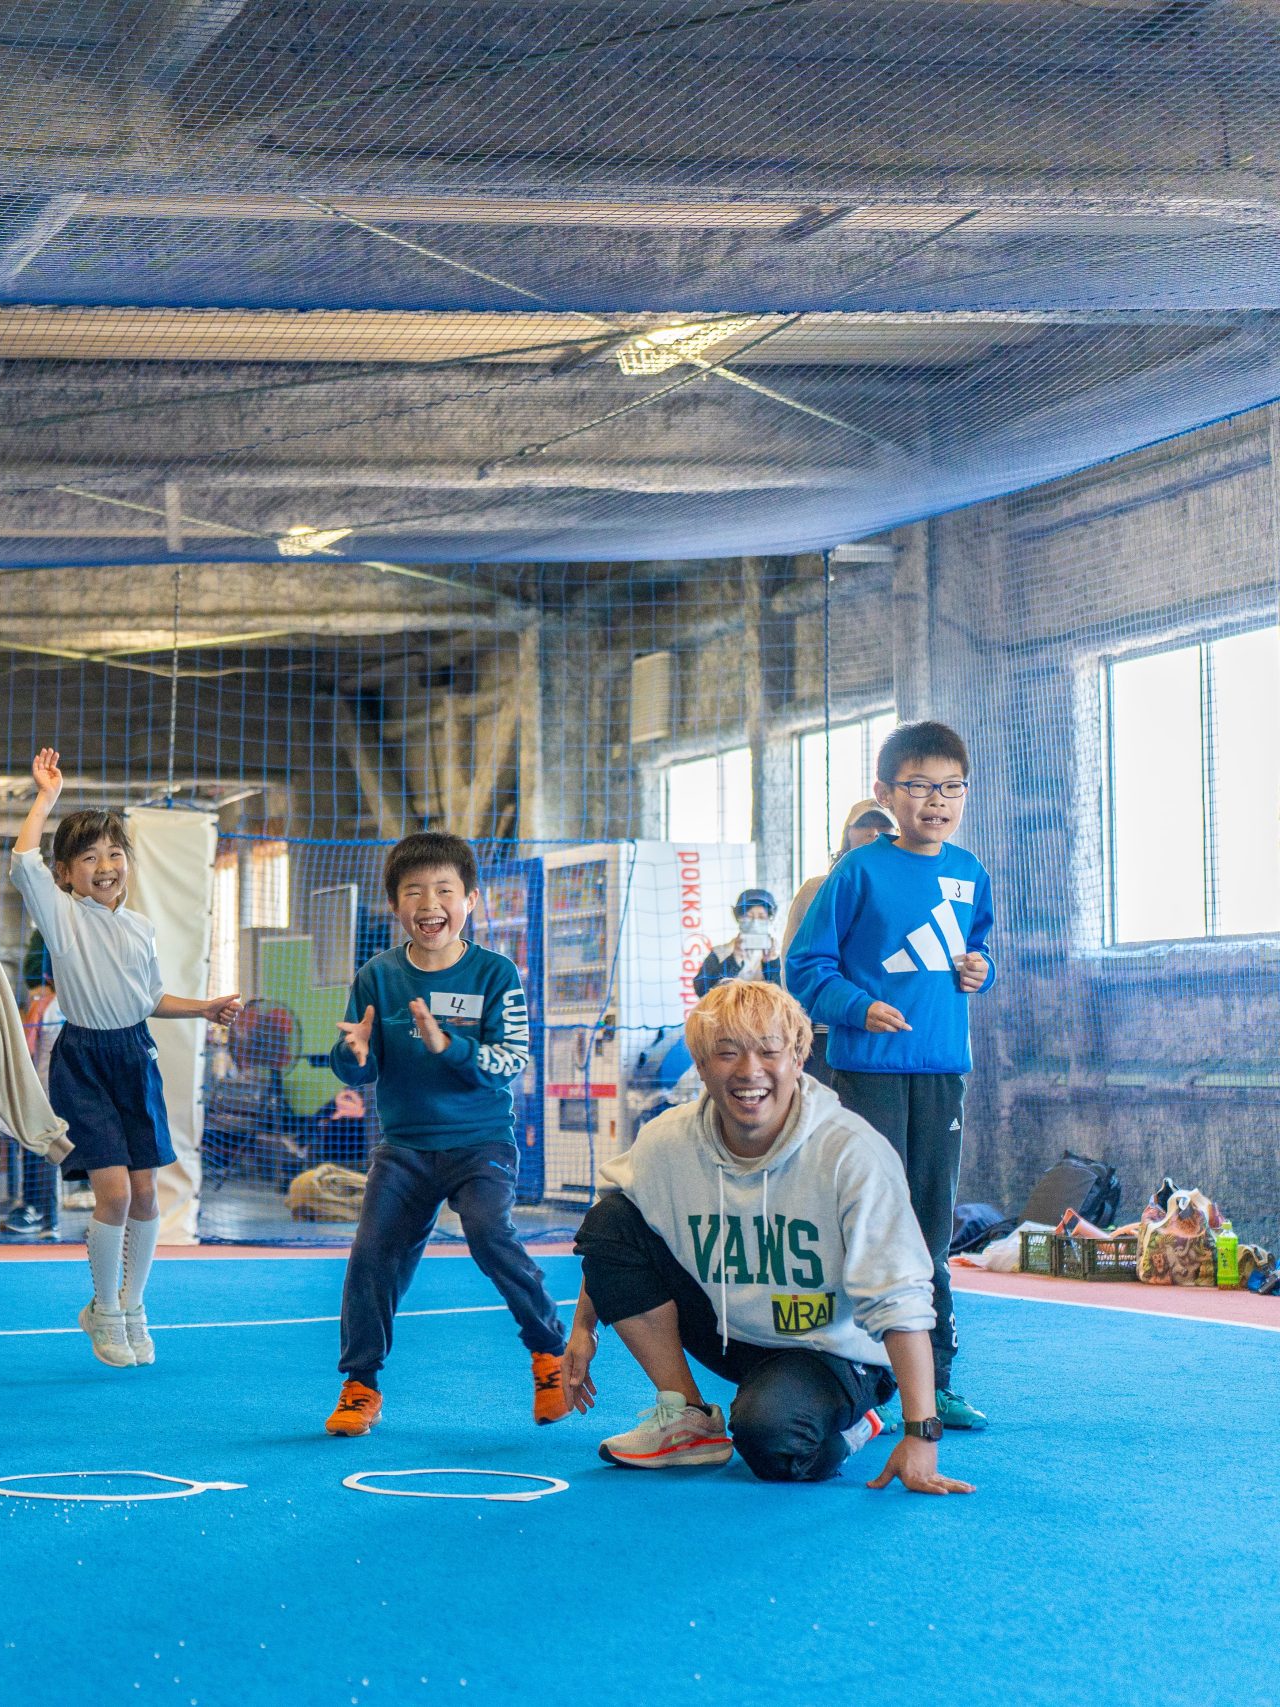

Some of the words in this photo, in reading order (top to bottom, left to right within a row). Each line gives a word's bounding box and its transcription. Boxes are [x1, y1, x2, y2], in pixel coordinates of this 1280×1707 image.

[954, 880, 962, 899] 3
[450, 996, 467, 1014] 4
[687, 1213, 825, 1289] VANS
